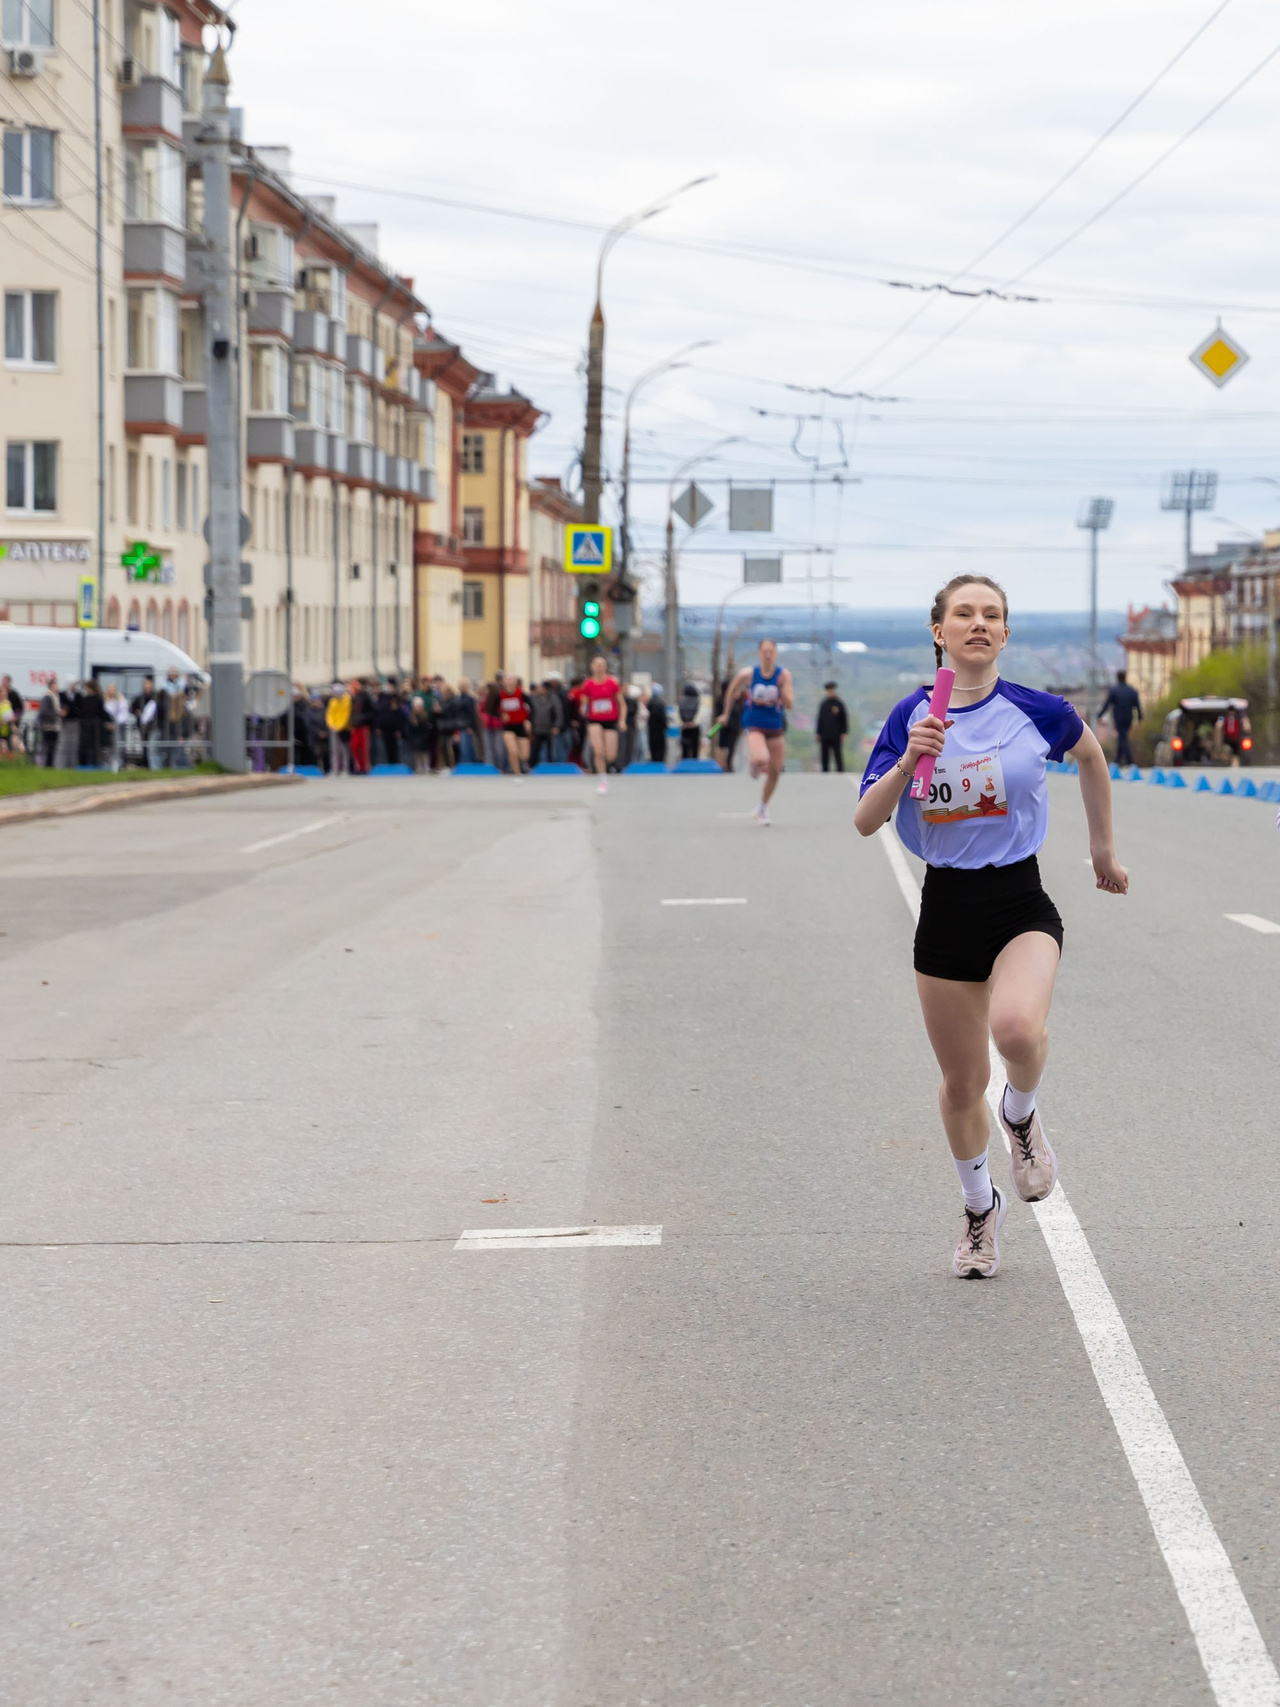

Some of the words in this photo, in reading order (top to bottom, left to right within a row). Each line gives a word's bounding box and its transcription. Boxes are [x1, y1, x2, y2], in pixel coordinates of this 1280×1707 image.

[10, 542, 90, 562] АПТЕКА
[928, 782, 952, 804] 90
[961, 778, 971, 792] 9
